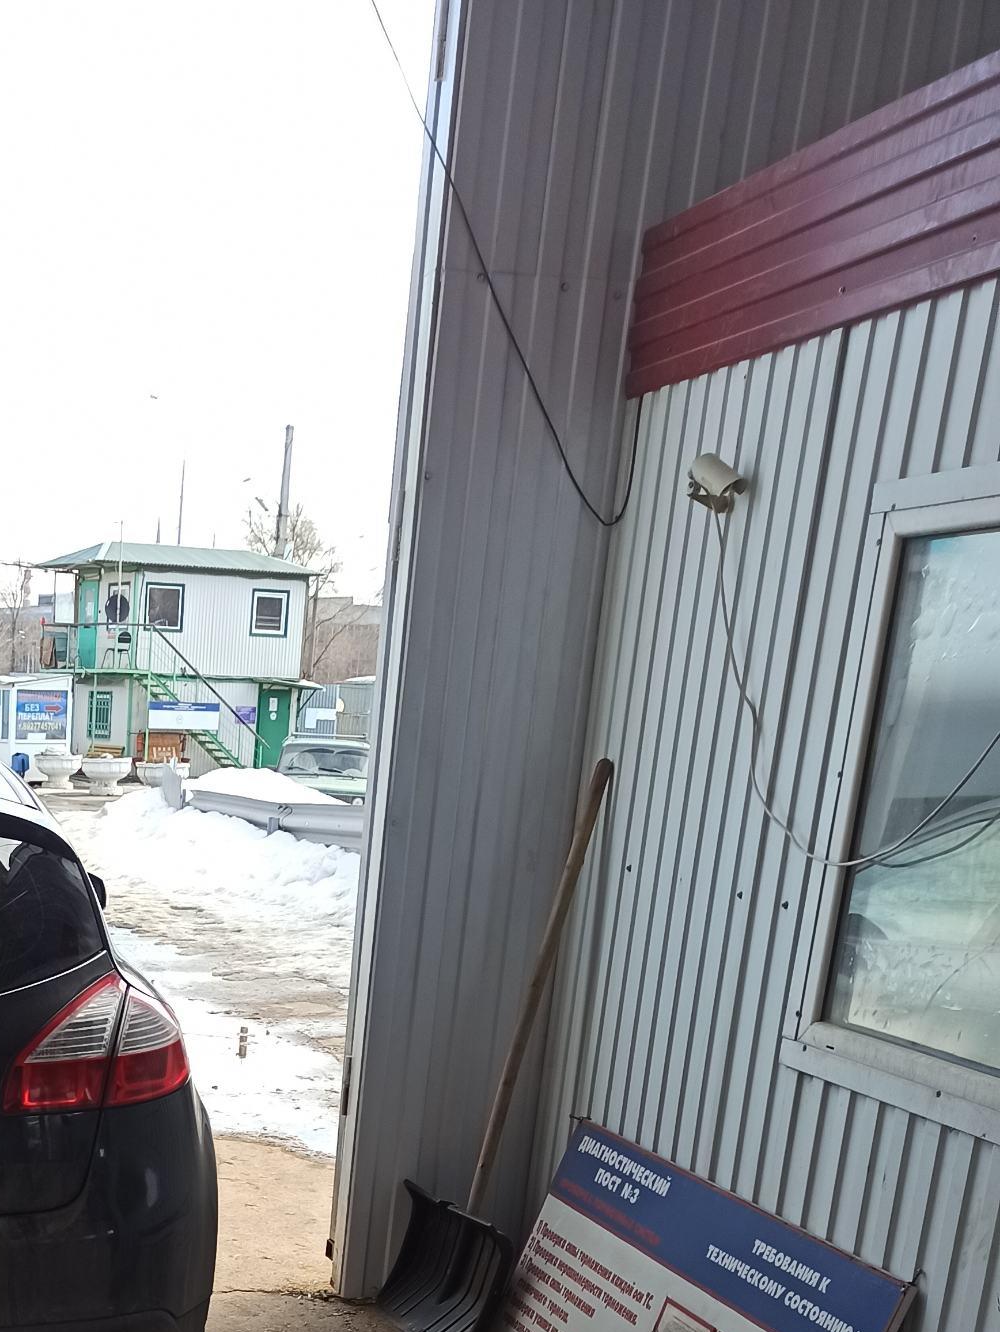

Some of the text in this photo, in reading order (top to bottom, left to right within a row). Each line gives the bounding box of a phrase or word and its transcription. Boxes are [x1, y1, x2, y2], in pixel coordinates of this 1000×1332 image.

[18, 712, 55, 721] ПЕРЕПЛАТ
[24, 703, 40, 712] БЕЗ
[578, 1136, 672, 1197] ДИАГНОСТИЧЕСКИЙ
[594, 1167, 640, 1204] ПОСТ №3
[706, 1244, 786, 1300] ТЕХНИЧЕСКОМУ
[752, 1239, 832, 1294] ТРЕБОВАНИЯ К
